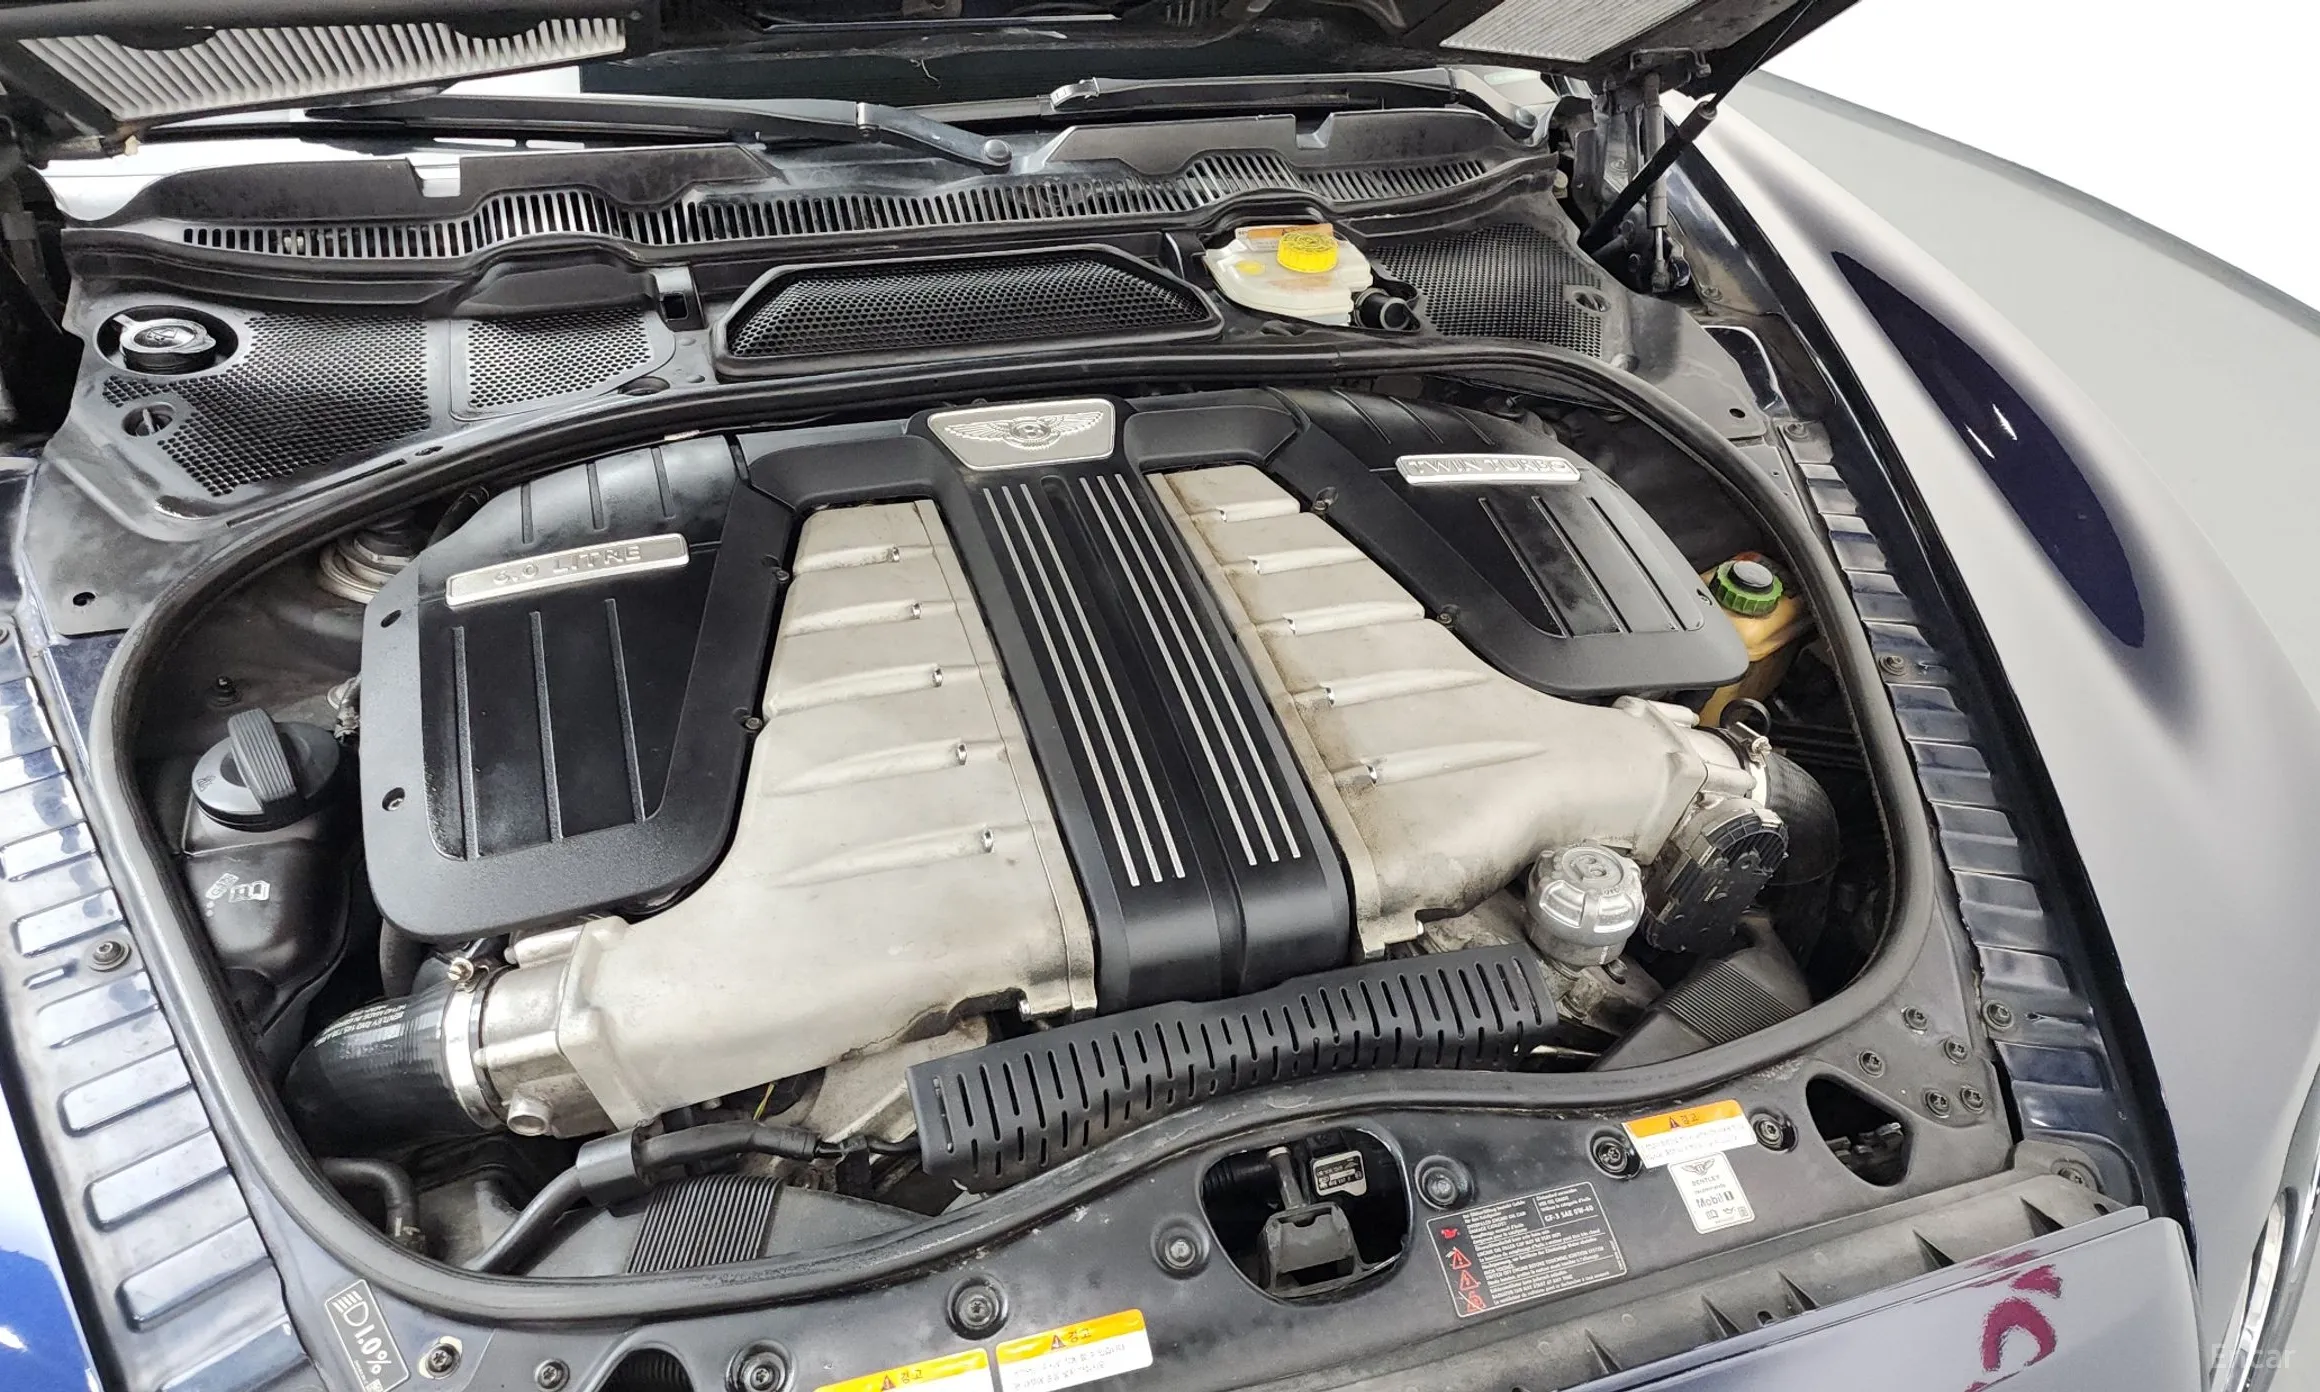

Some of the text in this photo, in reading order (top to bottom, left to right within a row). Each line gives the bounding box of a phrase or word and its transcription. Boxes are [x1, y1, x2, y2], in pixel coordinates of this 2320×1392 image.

[1409, 459, 1567, 474] TWIN TURBO
[553, 545, 642, 574] LITRE
[1069, 1328, 1091, 1342] 경고
[354, 1324, 392, 1375] 1.0%
